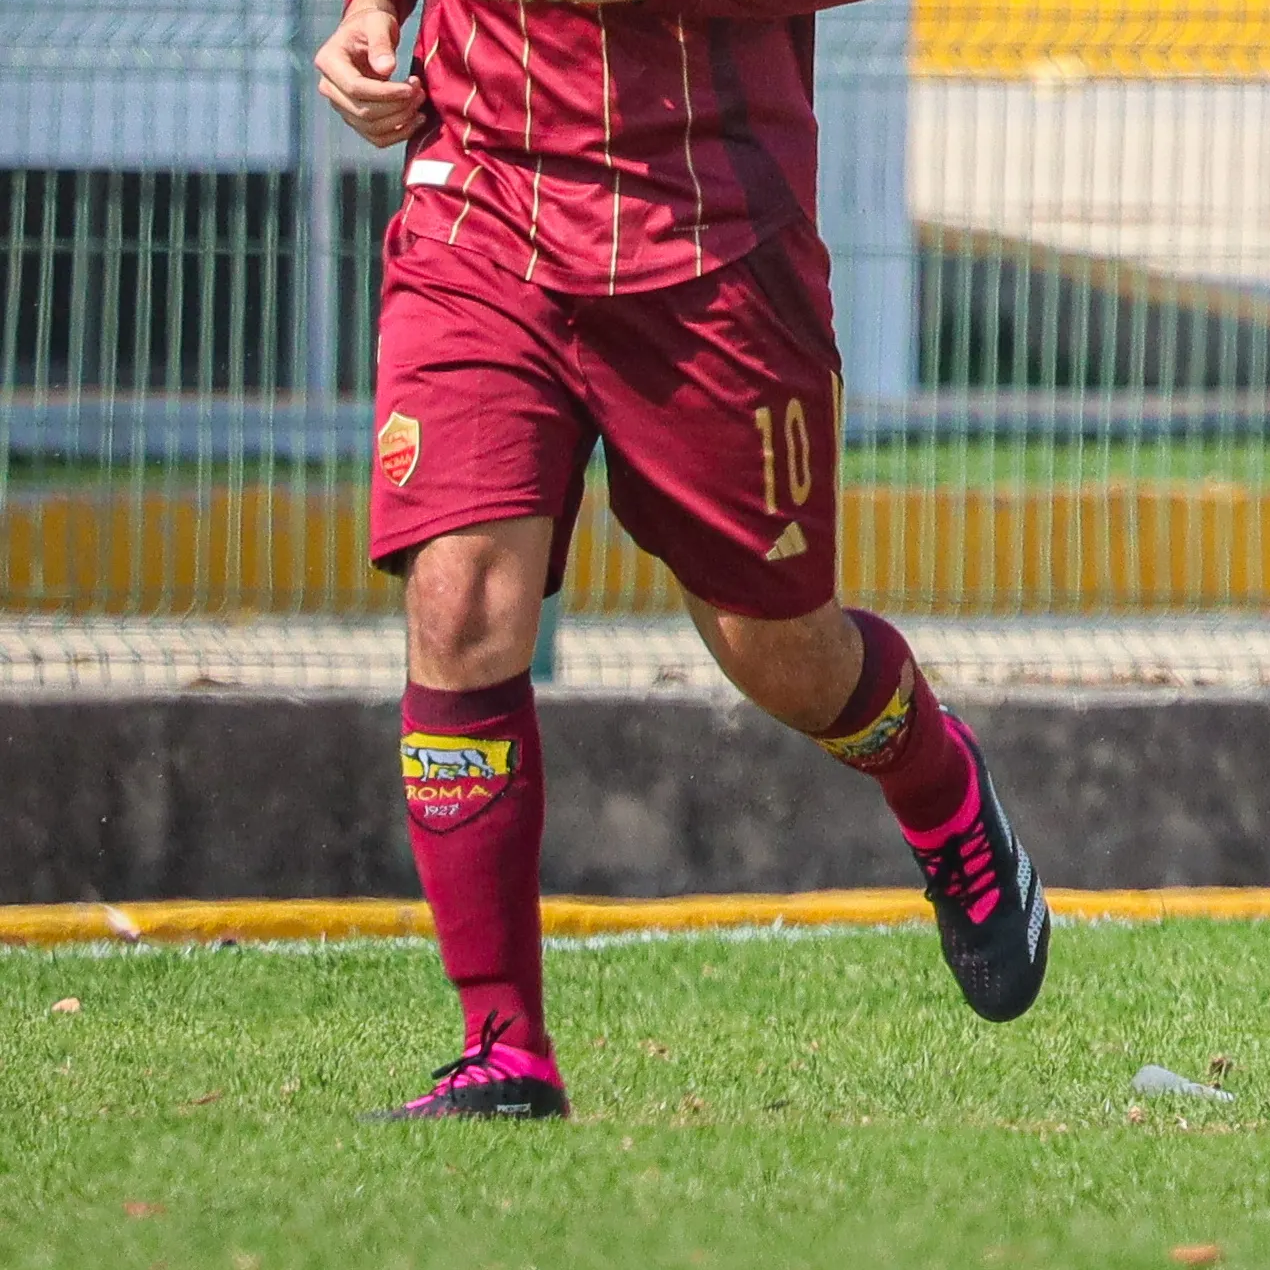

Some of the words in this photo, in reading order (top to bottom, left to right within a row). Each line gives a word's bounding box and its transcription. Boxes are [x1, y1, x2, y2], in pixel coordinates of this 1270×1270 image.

[755, 397, 811, 515] 10
[405, 783, 493, 801] ROMA
[424, 803, 460, 818] 1927
